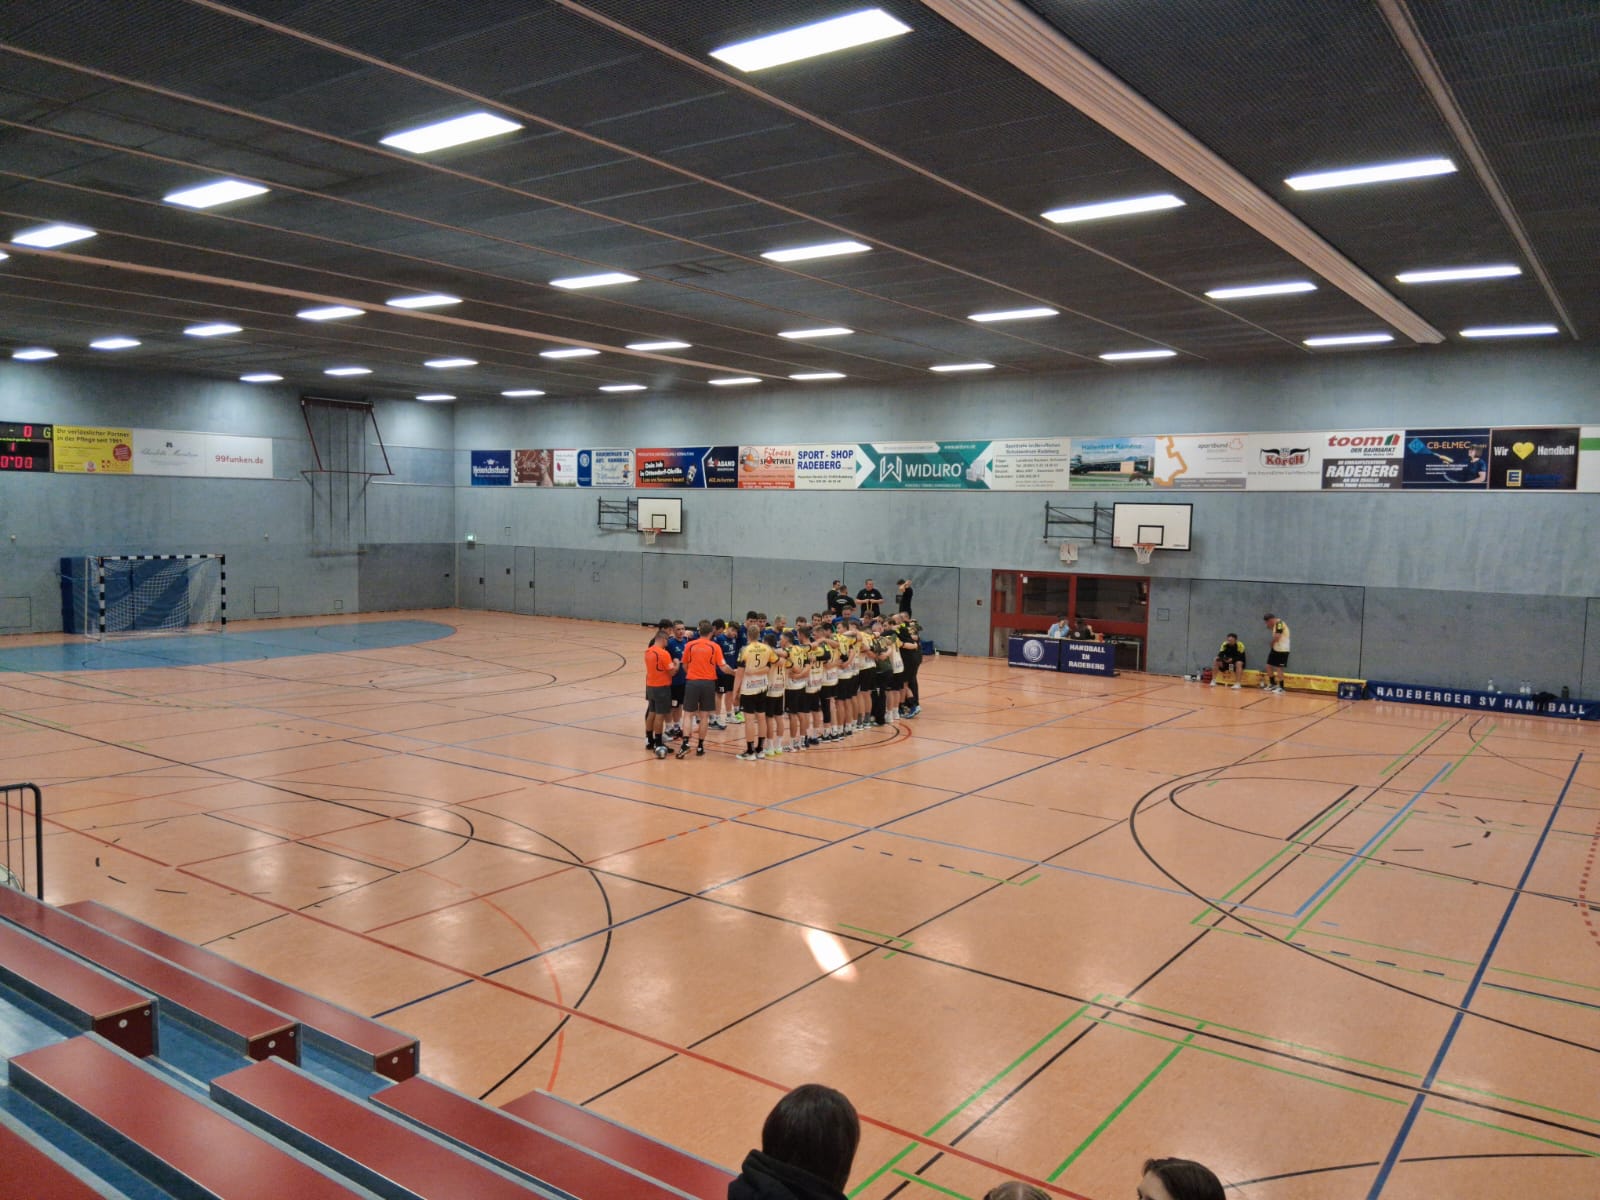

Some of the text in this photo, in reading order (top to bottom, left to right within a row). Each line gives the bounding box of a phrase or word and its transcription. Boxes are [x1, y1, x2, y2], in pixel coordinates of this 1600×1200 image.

[1328, 434, 1384, 447] toom
[1427, 441, 1471, 449] CB-ELMEC
[798, 451, 824, 459] SPORT
[831, 450, 853, 459] SHOP
[1494, 445, 1575, 456] Wir Handball
[215, 455, 264, 464] 99funken.de
[798, 461, 841, 470] RADEBERG
[905, 463, 961, 477] WIDURO
[1326, 465, 1399, 477] RADEBERG
[1069, 644, 1106, 653] HANDBALL
[755, 654, 760, 668] 5
[1068, 661, 1105, 670] RADEBERG
[1376, 687, 1471, 705] RADEBERGER
[1479, 696, 1496, 707] SV
